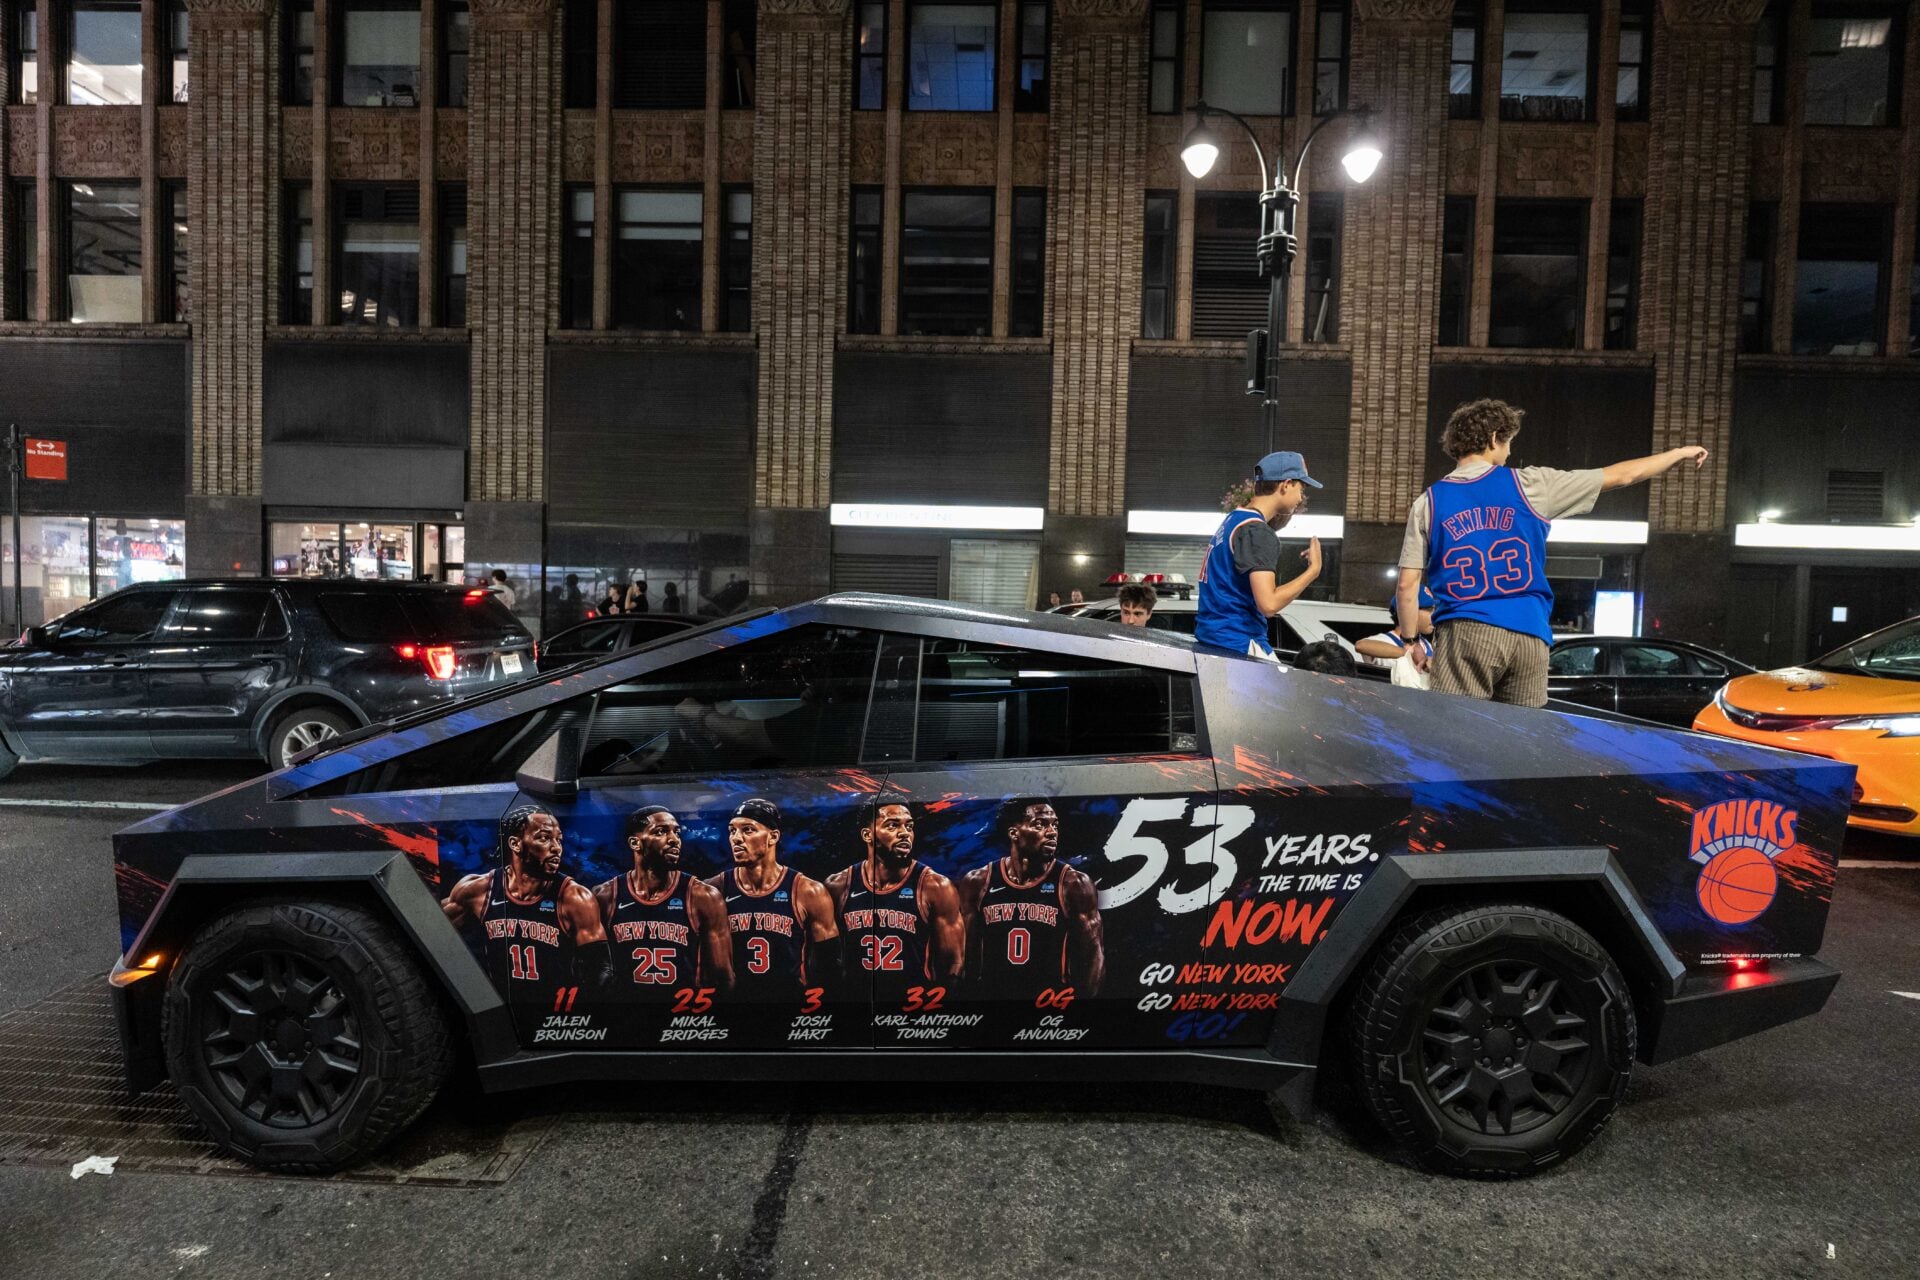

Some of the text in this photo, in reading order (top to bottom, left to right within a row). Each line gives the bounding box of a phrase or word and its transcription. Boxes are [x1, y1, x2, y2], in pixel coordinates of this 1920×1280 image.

[1442, 507, 1515, 541] EWING
[1443, 537, 1533, 600] 33
[1689, 799, 1798, 857] KNICKS
[1096, 797, 1379, 915] 53 YEARS.
[1258, 873, 1363, 893] THE TIME IS
[728, 912, 793, 938] EW YORK
[844, 908, 917, 934] NEW YORK
[983, 902, 1058, 927] NEW YORK
[484, 918, 559, 947] NEW YORK
[613, 920, 688, 946] NEW YORK
[747, 936, 770, 974] 3
[860, 934, 903, 970] 32
[1007, 927, 1030, 965] 0
[509, 944, 539, 980] 11
[632, 947, 677, 985] 25
[1139, 961, 1292, 986] GO NEW YORK
[553, 986, 579, 1013] 11
[671, 987, 716, 1014] 25
[801, 987, 825, 1013] 3
[902, 986, 946, 1012] 32
[1034, 986, 1075, 1009] OG
[1136, 992, 1282, 1012] GO NEW YORK
[542, 1015, 592, 1028] JALEN
[670, 1015, 716, 1028] MIKAL
[791, 1014, 833, 1028] JOSH
[871, 1014, 984, 1026] KARL-ANTHONY
[1039, 1015, 1064, 1027] OG
[1165, 1012, 1247, 1041] GO!
[533, 1027, 608, 1042] BRUNSON
[660, 1028, 729, 1042] BRIDGES
[787, 1028, 833, 1041] HART
[896, 1027, 949, 1040] TOWNS
[1013, 1028, 1090, 1041] ANUNOBY
